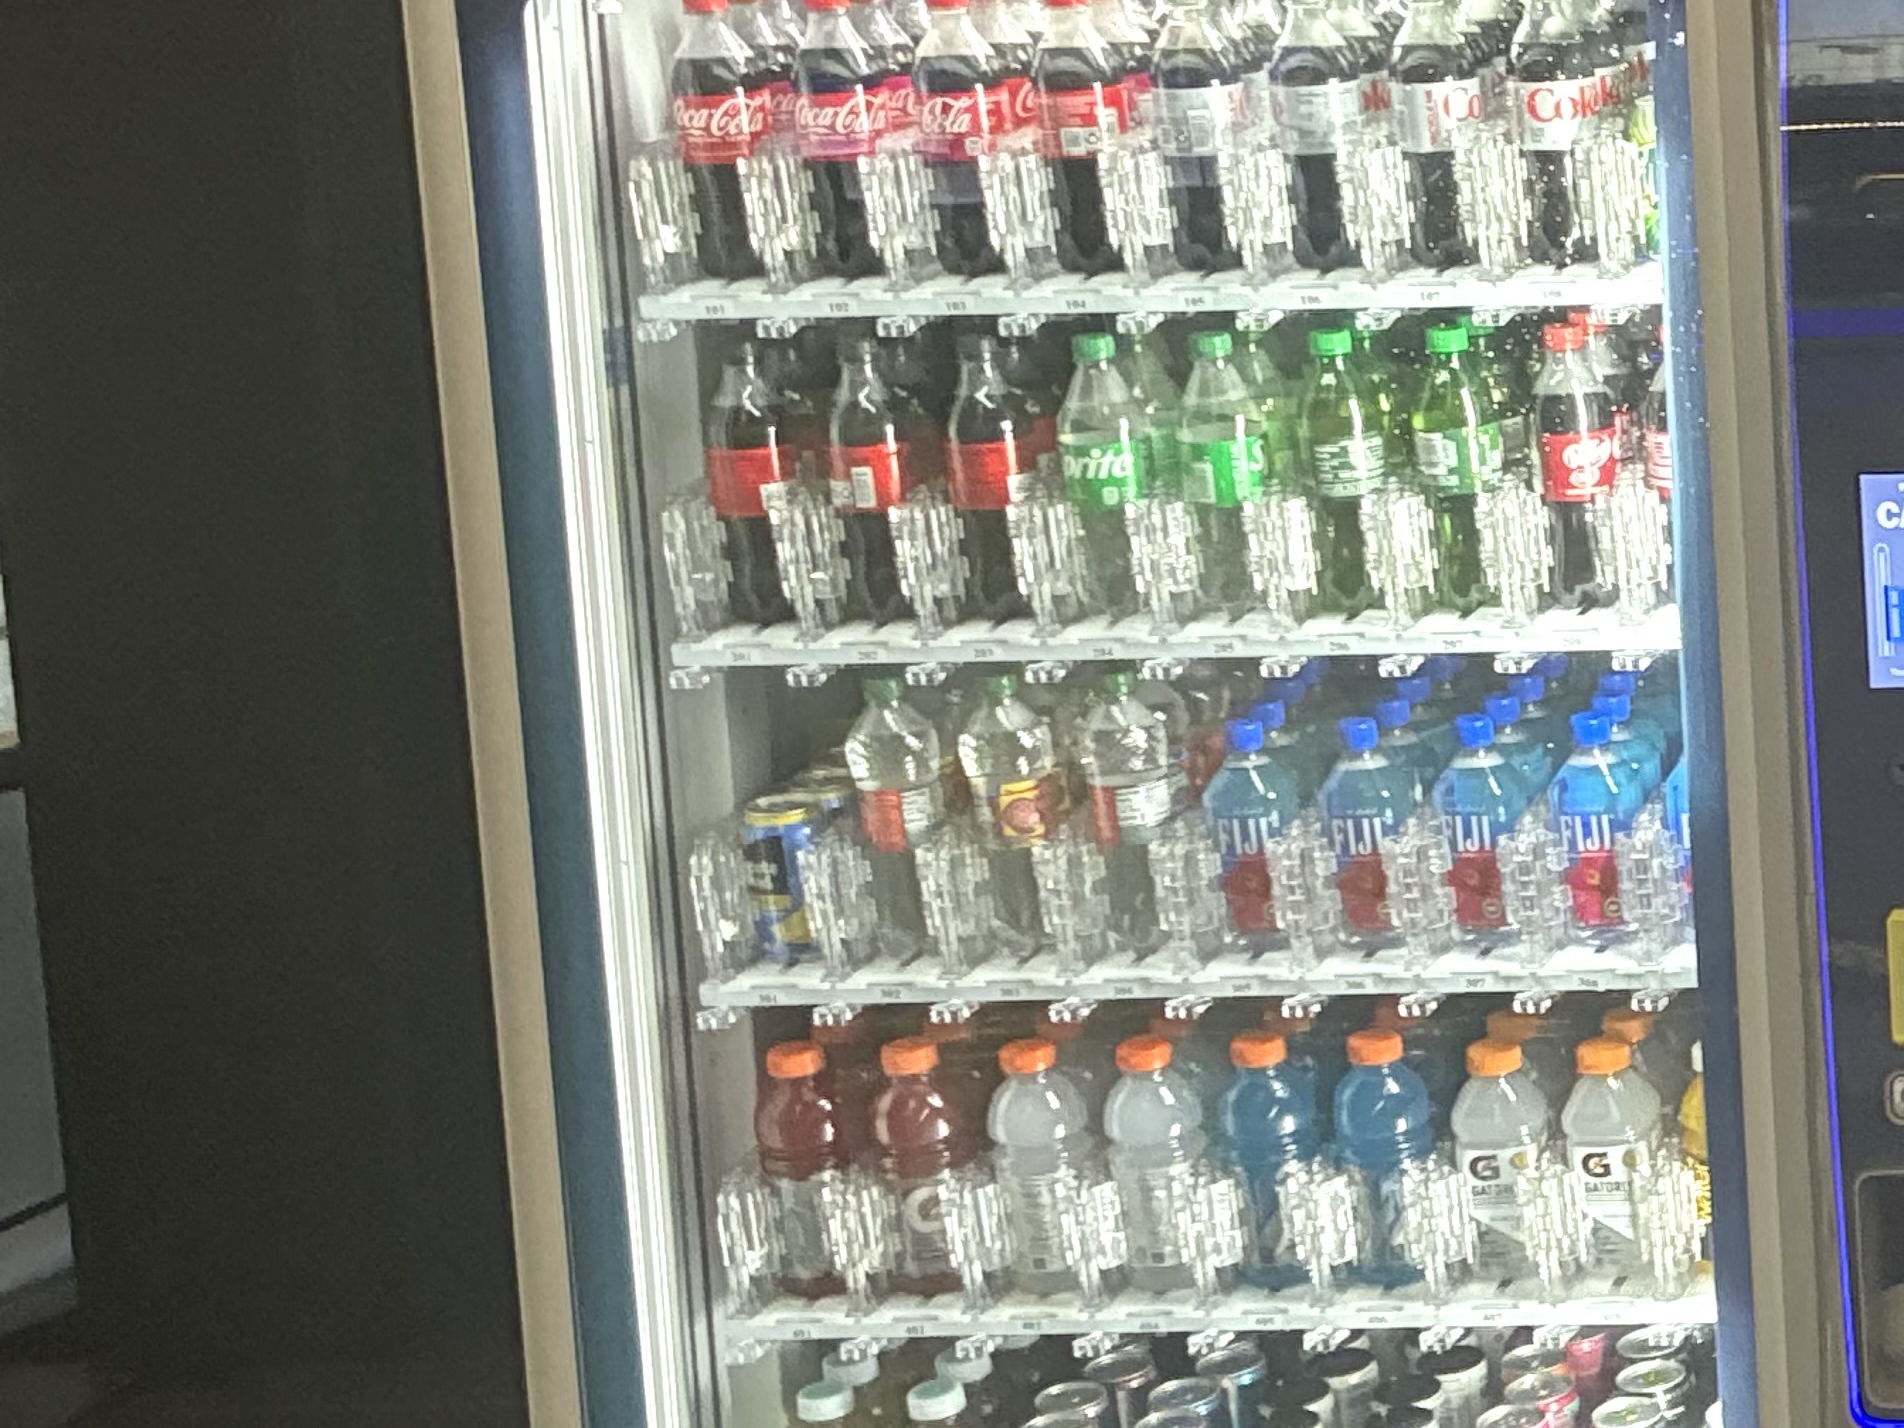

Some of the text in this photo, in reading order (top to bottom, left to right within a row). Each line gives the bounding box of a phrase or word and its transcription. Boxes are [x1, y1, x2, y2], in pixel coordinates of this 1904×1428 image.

[1217, 818, 1270, 855] FIJI
[1332, 818, 1383, 855] FIJI
[1442, 815, 1492, 852] FIJI
[1561, 815, 1610, 852] FIJI
[1469, 1154, 1501, 1181] G
[1582, 1152, 1611, 1178] G
